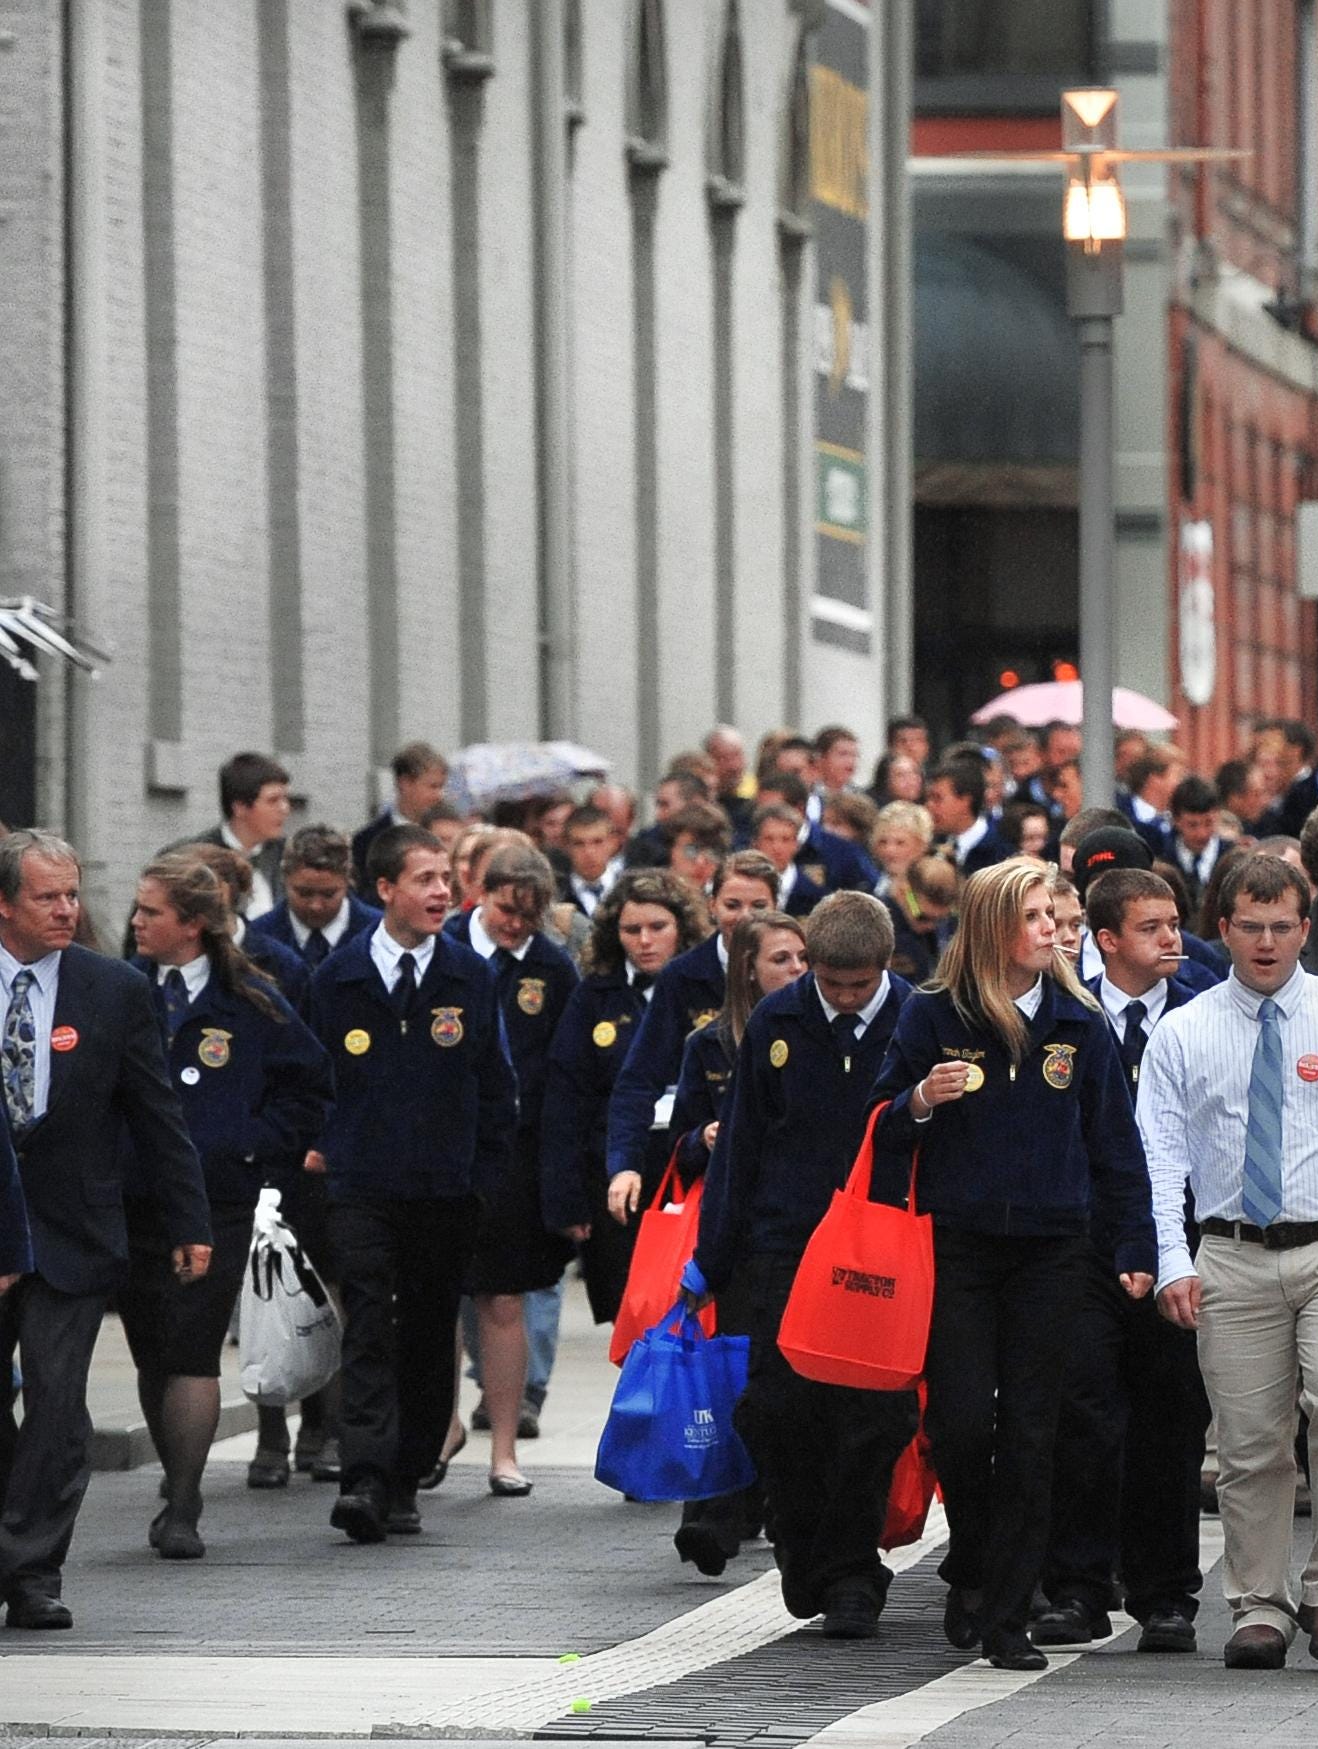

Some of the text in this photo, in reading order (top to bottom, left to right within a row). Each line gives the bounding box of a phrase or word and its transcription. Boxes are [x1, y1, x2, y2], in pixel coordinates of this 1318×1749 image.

[848, 1269, 896, 1288] TRACTOR
[845, 1279, 879, 1297] SUPPLY
[693, 1408, 714, 1424] UK
